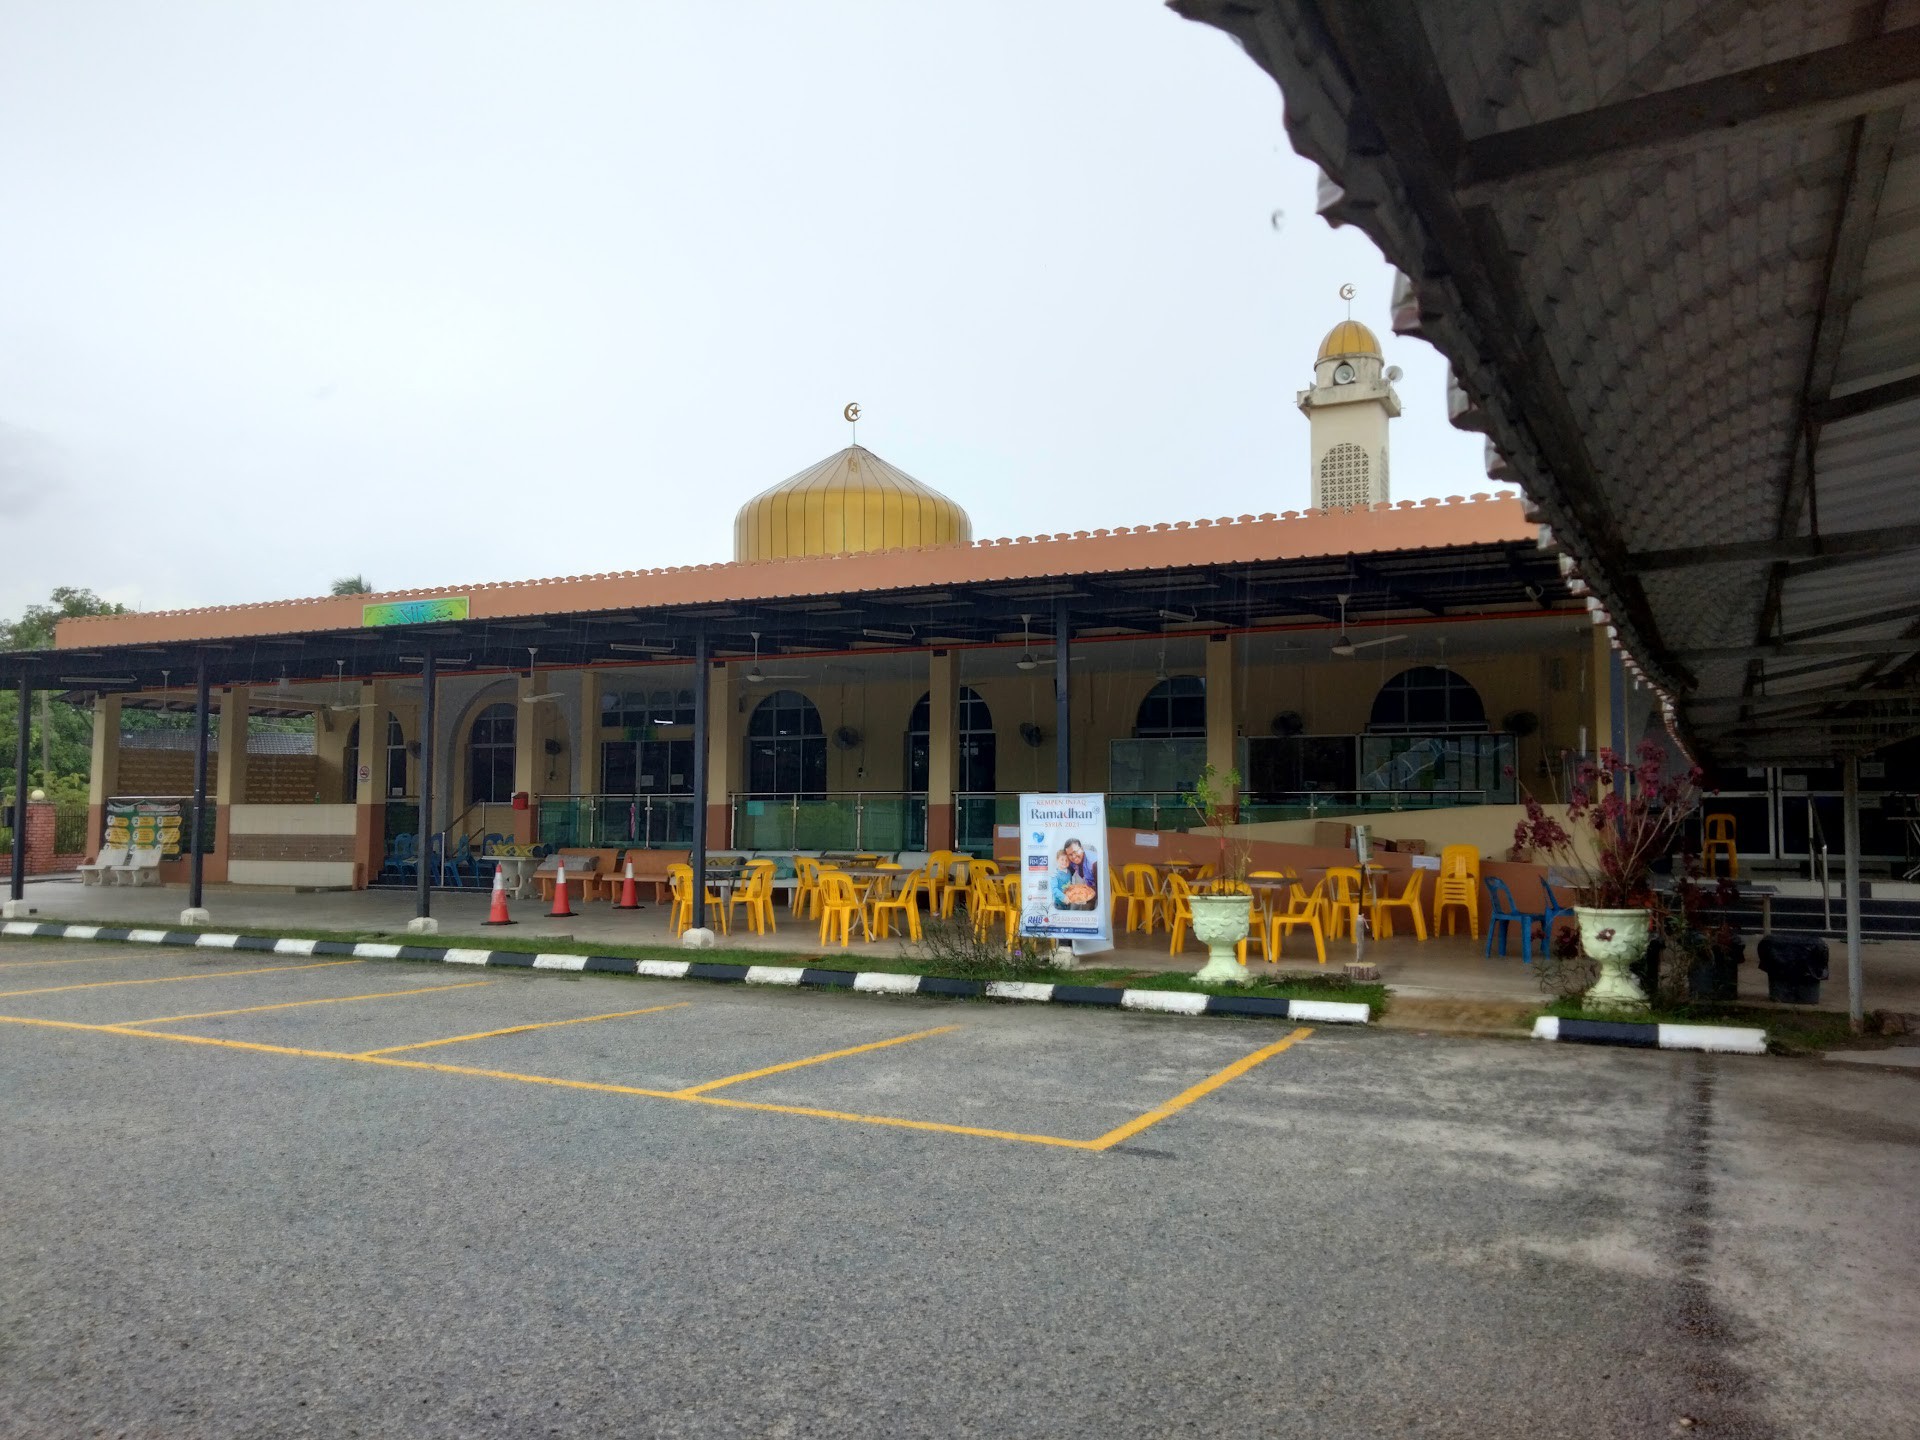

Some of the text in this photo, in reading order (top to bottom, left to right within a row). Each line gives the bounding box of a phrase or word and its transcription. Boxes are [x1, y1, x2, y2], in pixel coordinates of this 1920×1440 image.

[1031, 807, 1093, 819] Ramadhan
[1039, 857, 1048, 866] 25
[1027, 915, 1044, 924] RHB
